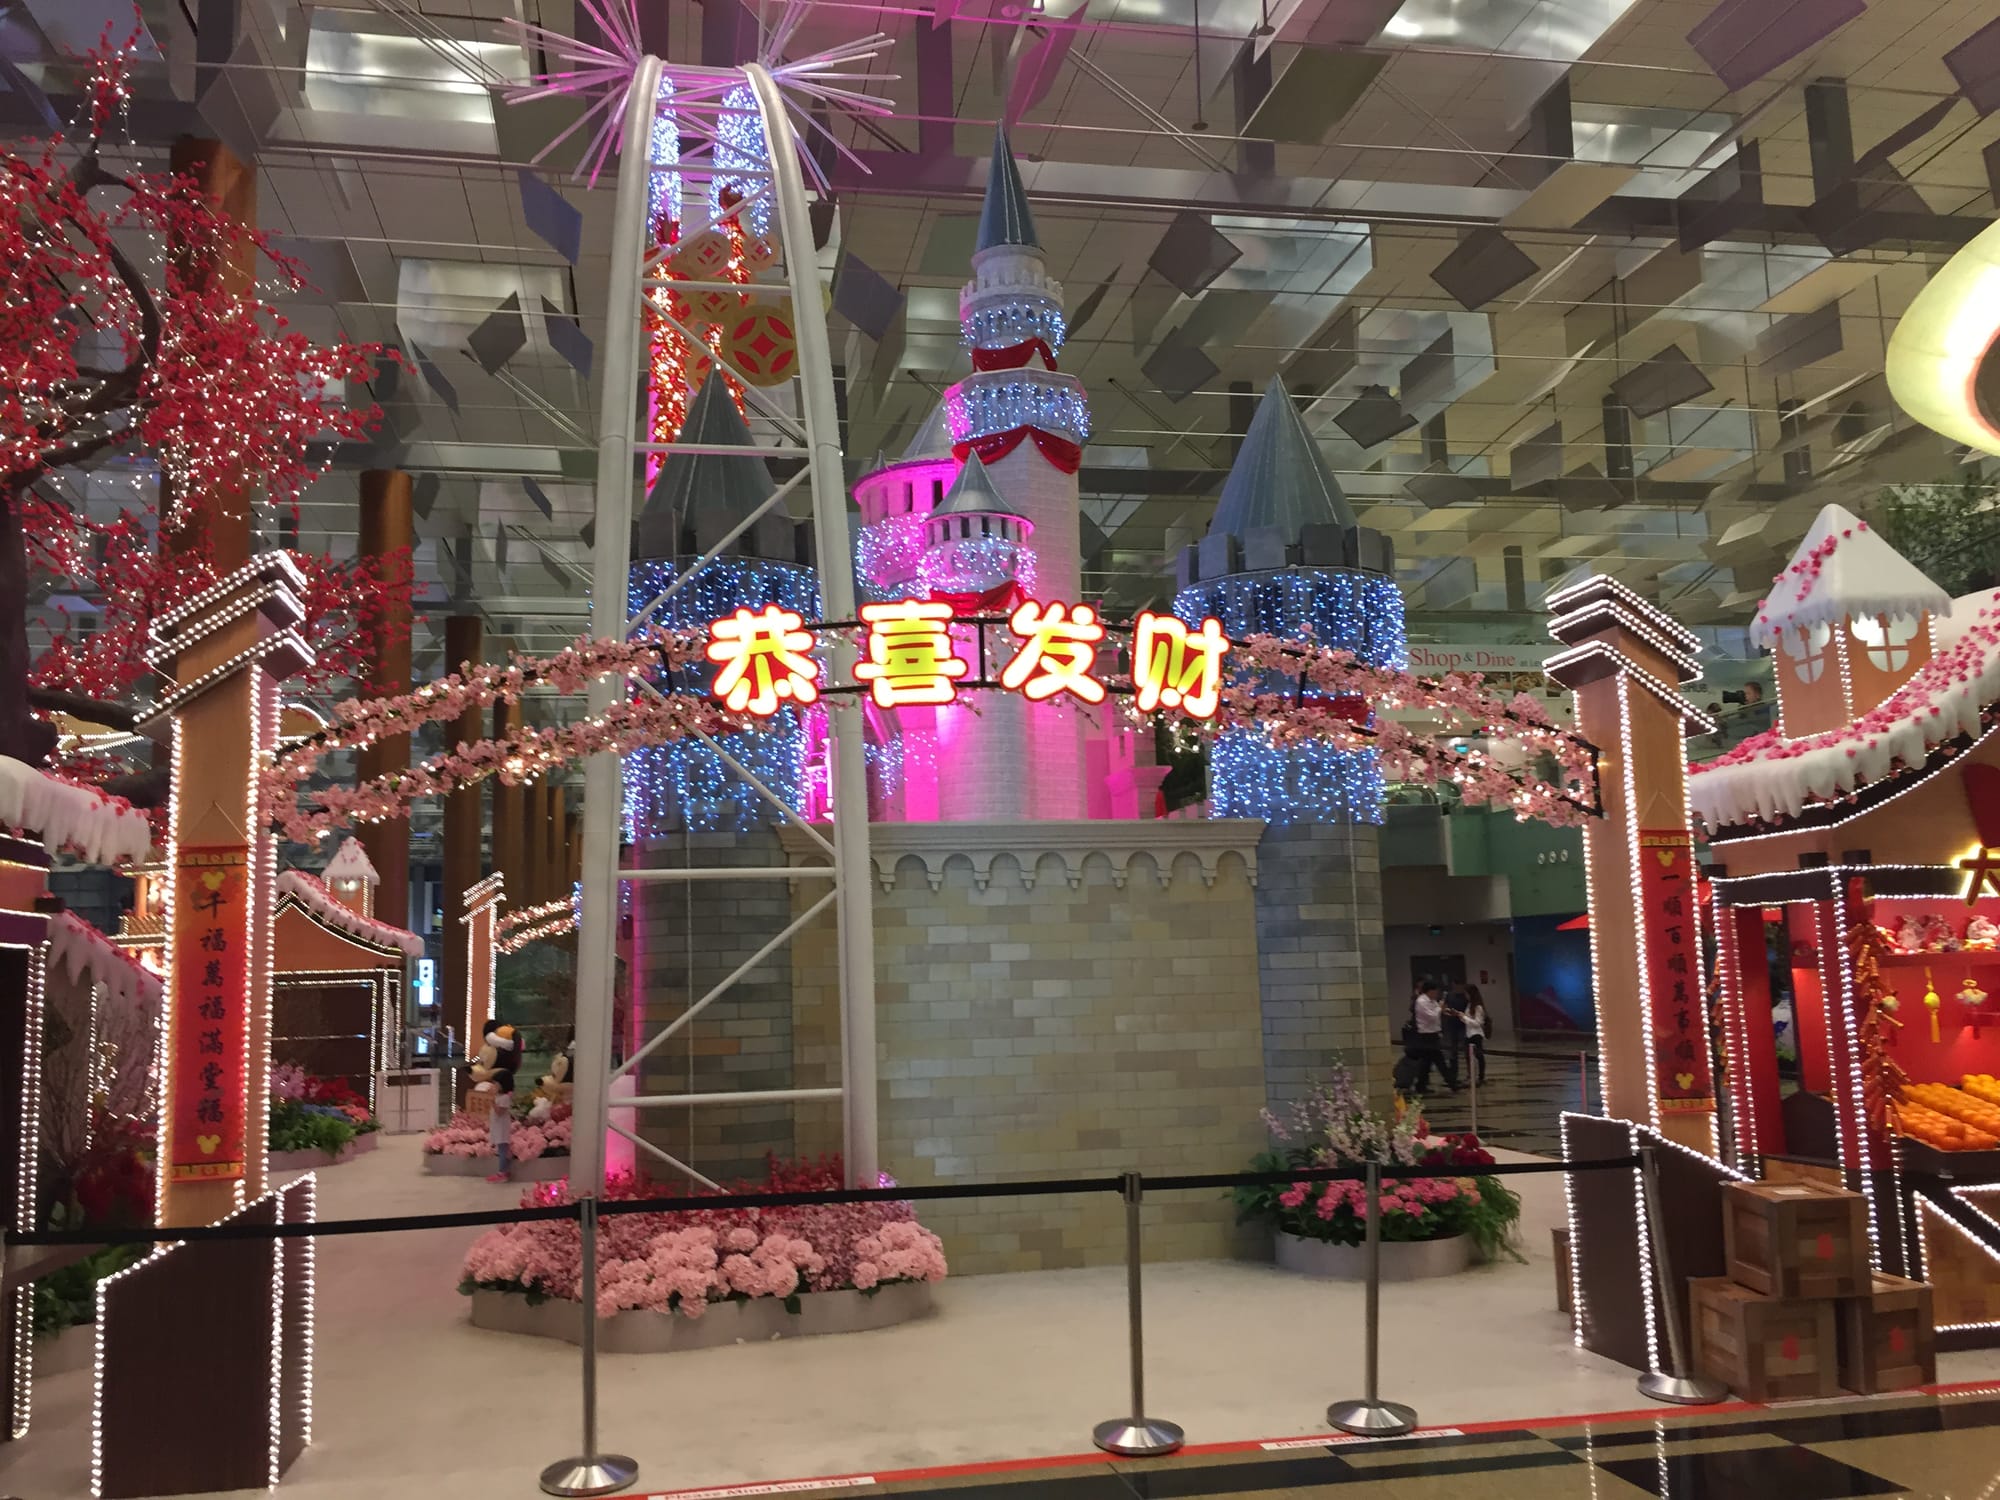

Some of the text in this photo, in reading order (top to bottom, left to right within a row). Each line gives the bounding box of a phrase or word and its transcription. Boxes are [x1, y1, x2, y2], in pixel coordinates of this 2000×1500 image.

[705, 600, 1230, 718] 恭喜发财
[1410, 648, 1462, 671] Shop
[1464, 652, 1474, 663] &
[1476, 650, 1516, 667] Dine
[727, 1485, 772, 1496] Mind
